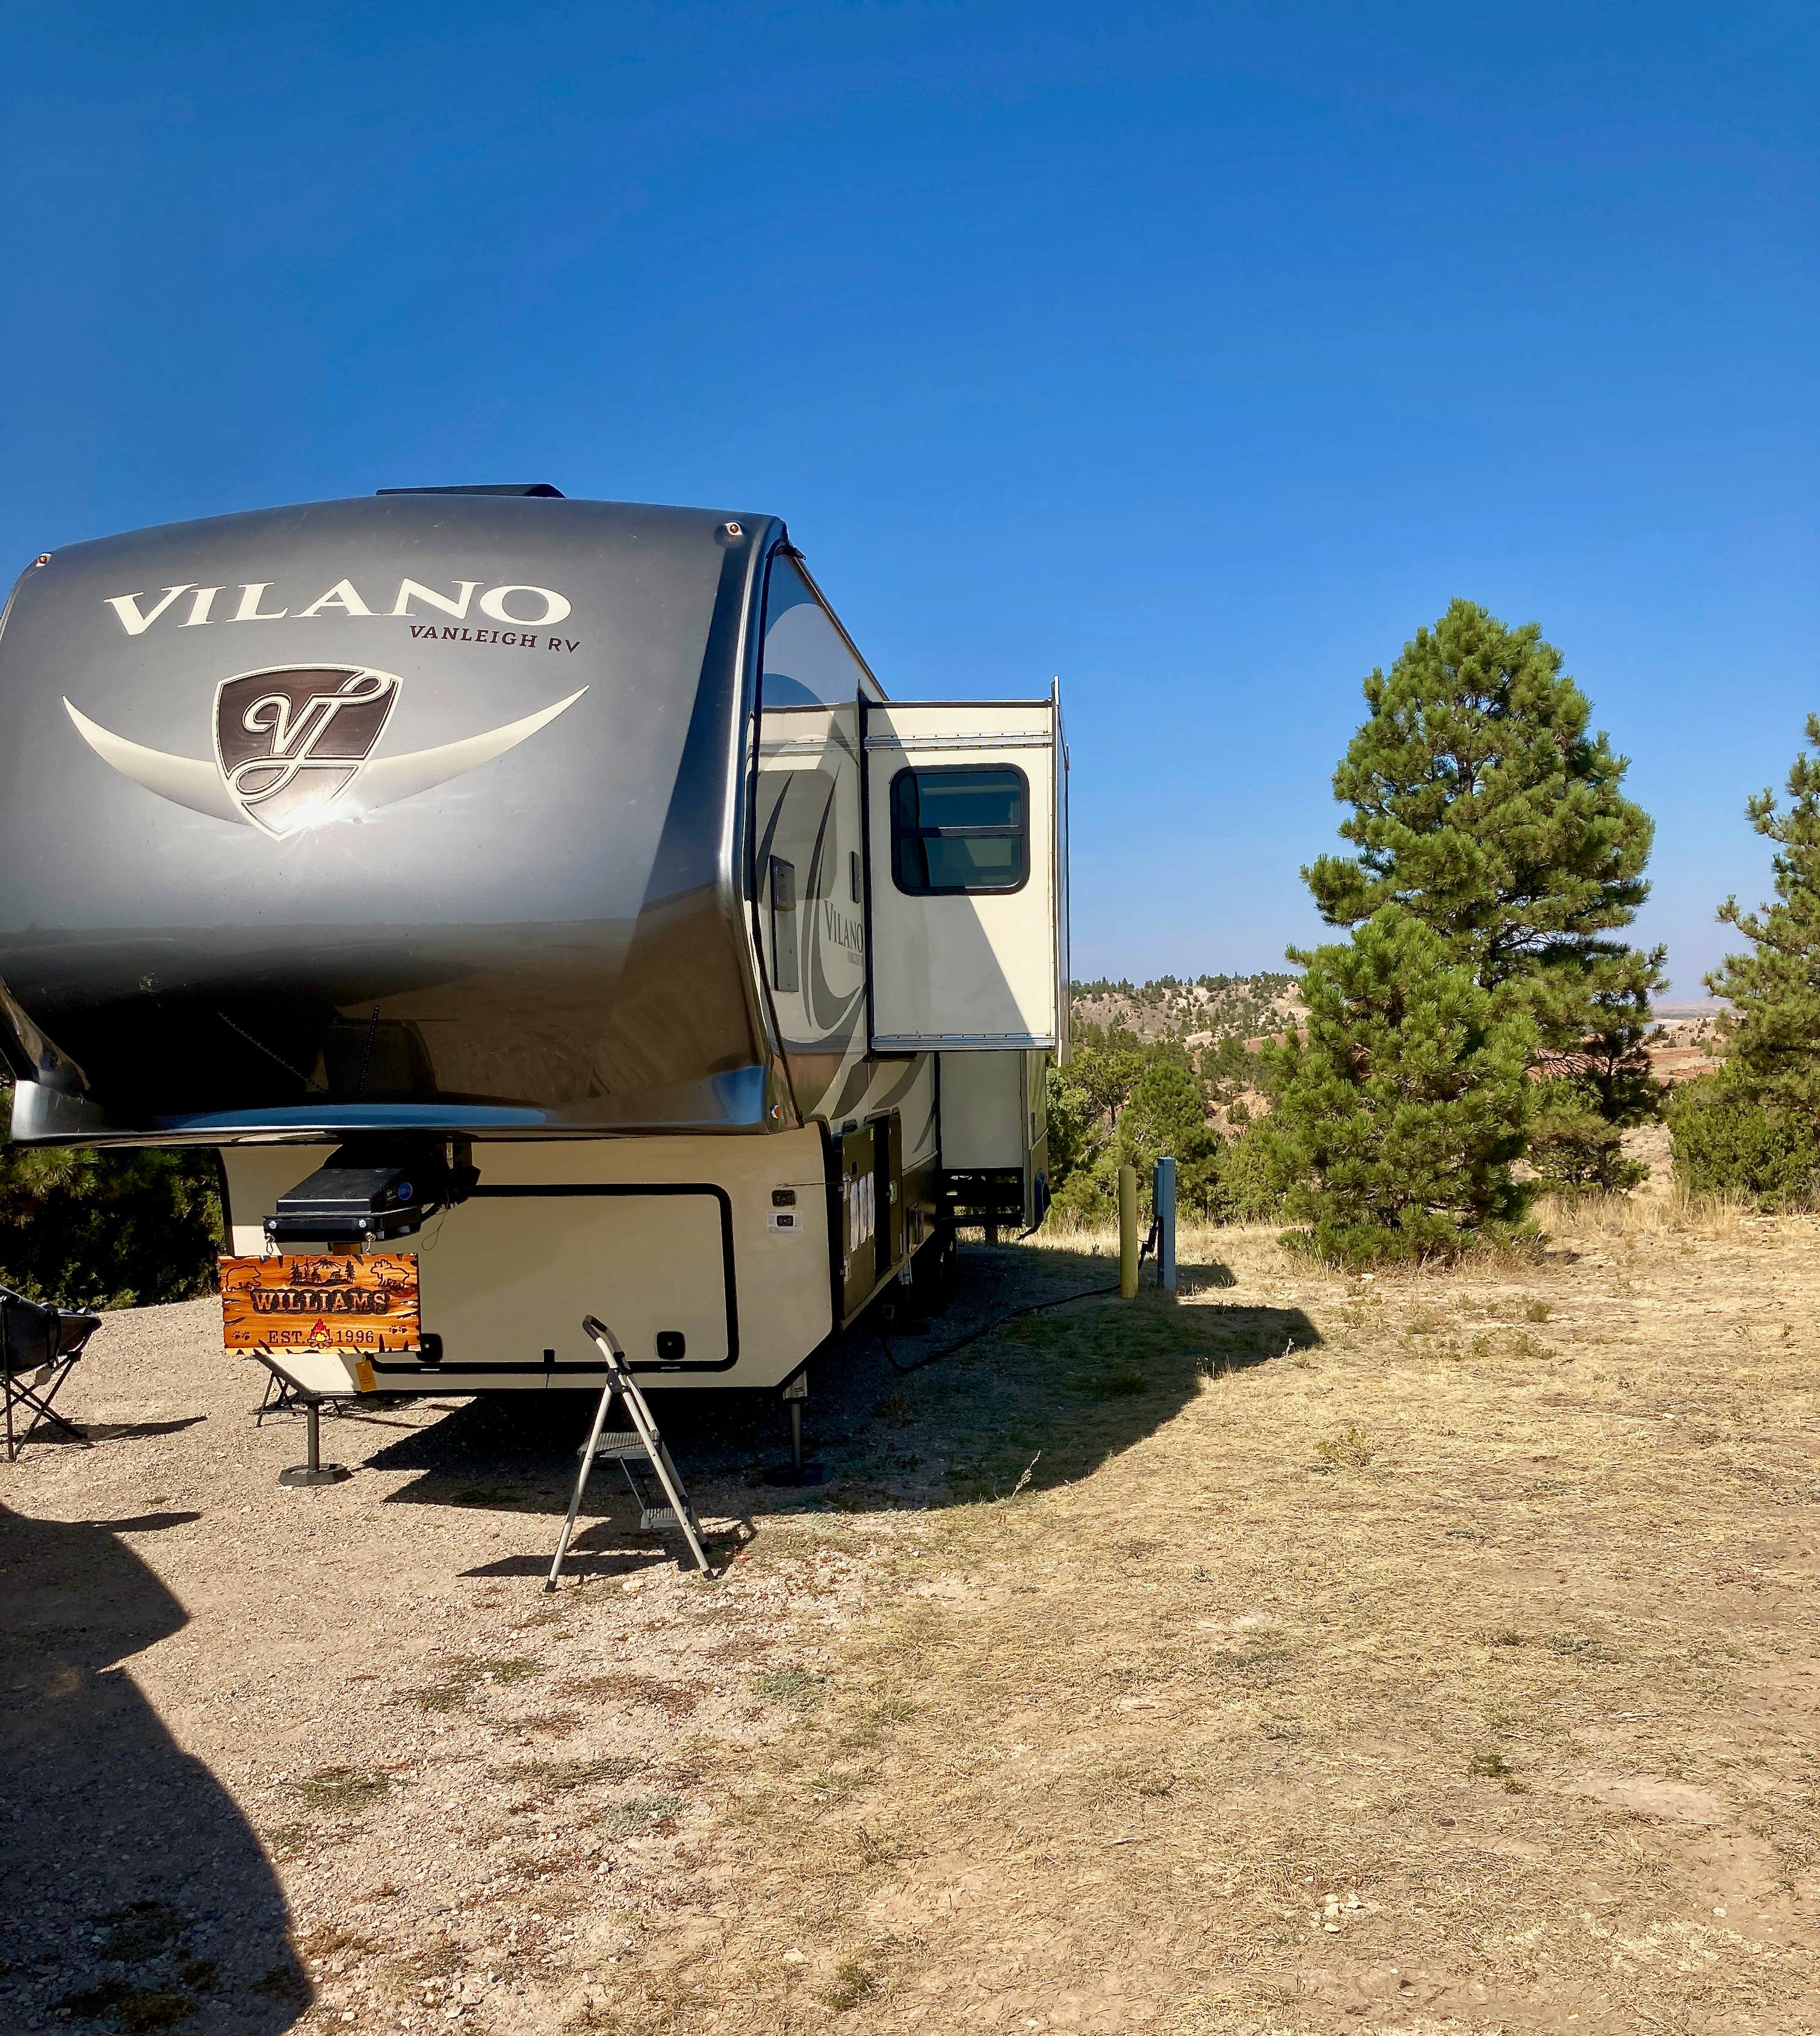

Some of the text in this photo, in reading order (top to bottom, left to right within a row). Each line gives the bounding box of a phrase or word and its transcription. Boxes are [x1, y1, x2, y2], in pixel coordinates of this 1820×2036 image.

[104, 577, 572, 637] VILANO
[409, 624, 581, 654] VANLEIGH RV
[823, 899, 863, 953] VILANO
[255, 1292, 387, 1312] WILLIAMS
[268, 1329, 374, 1344] EST. 1996
